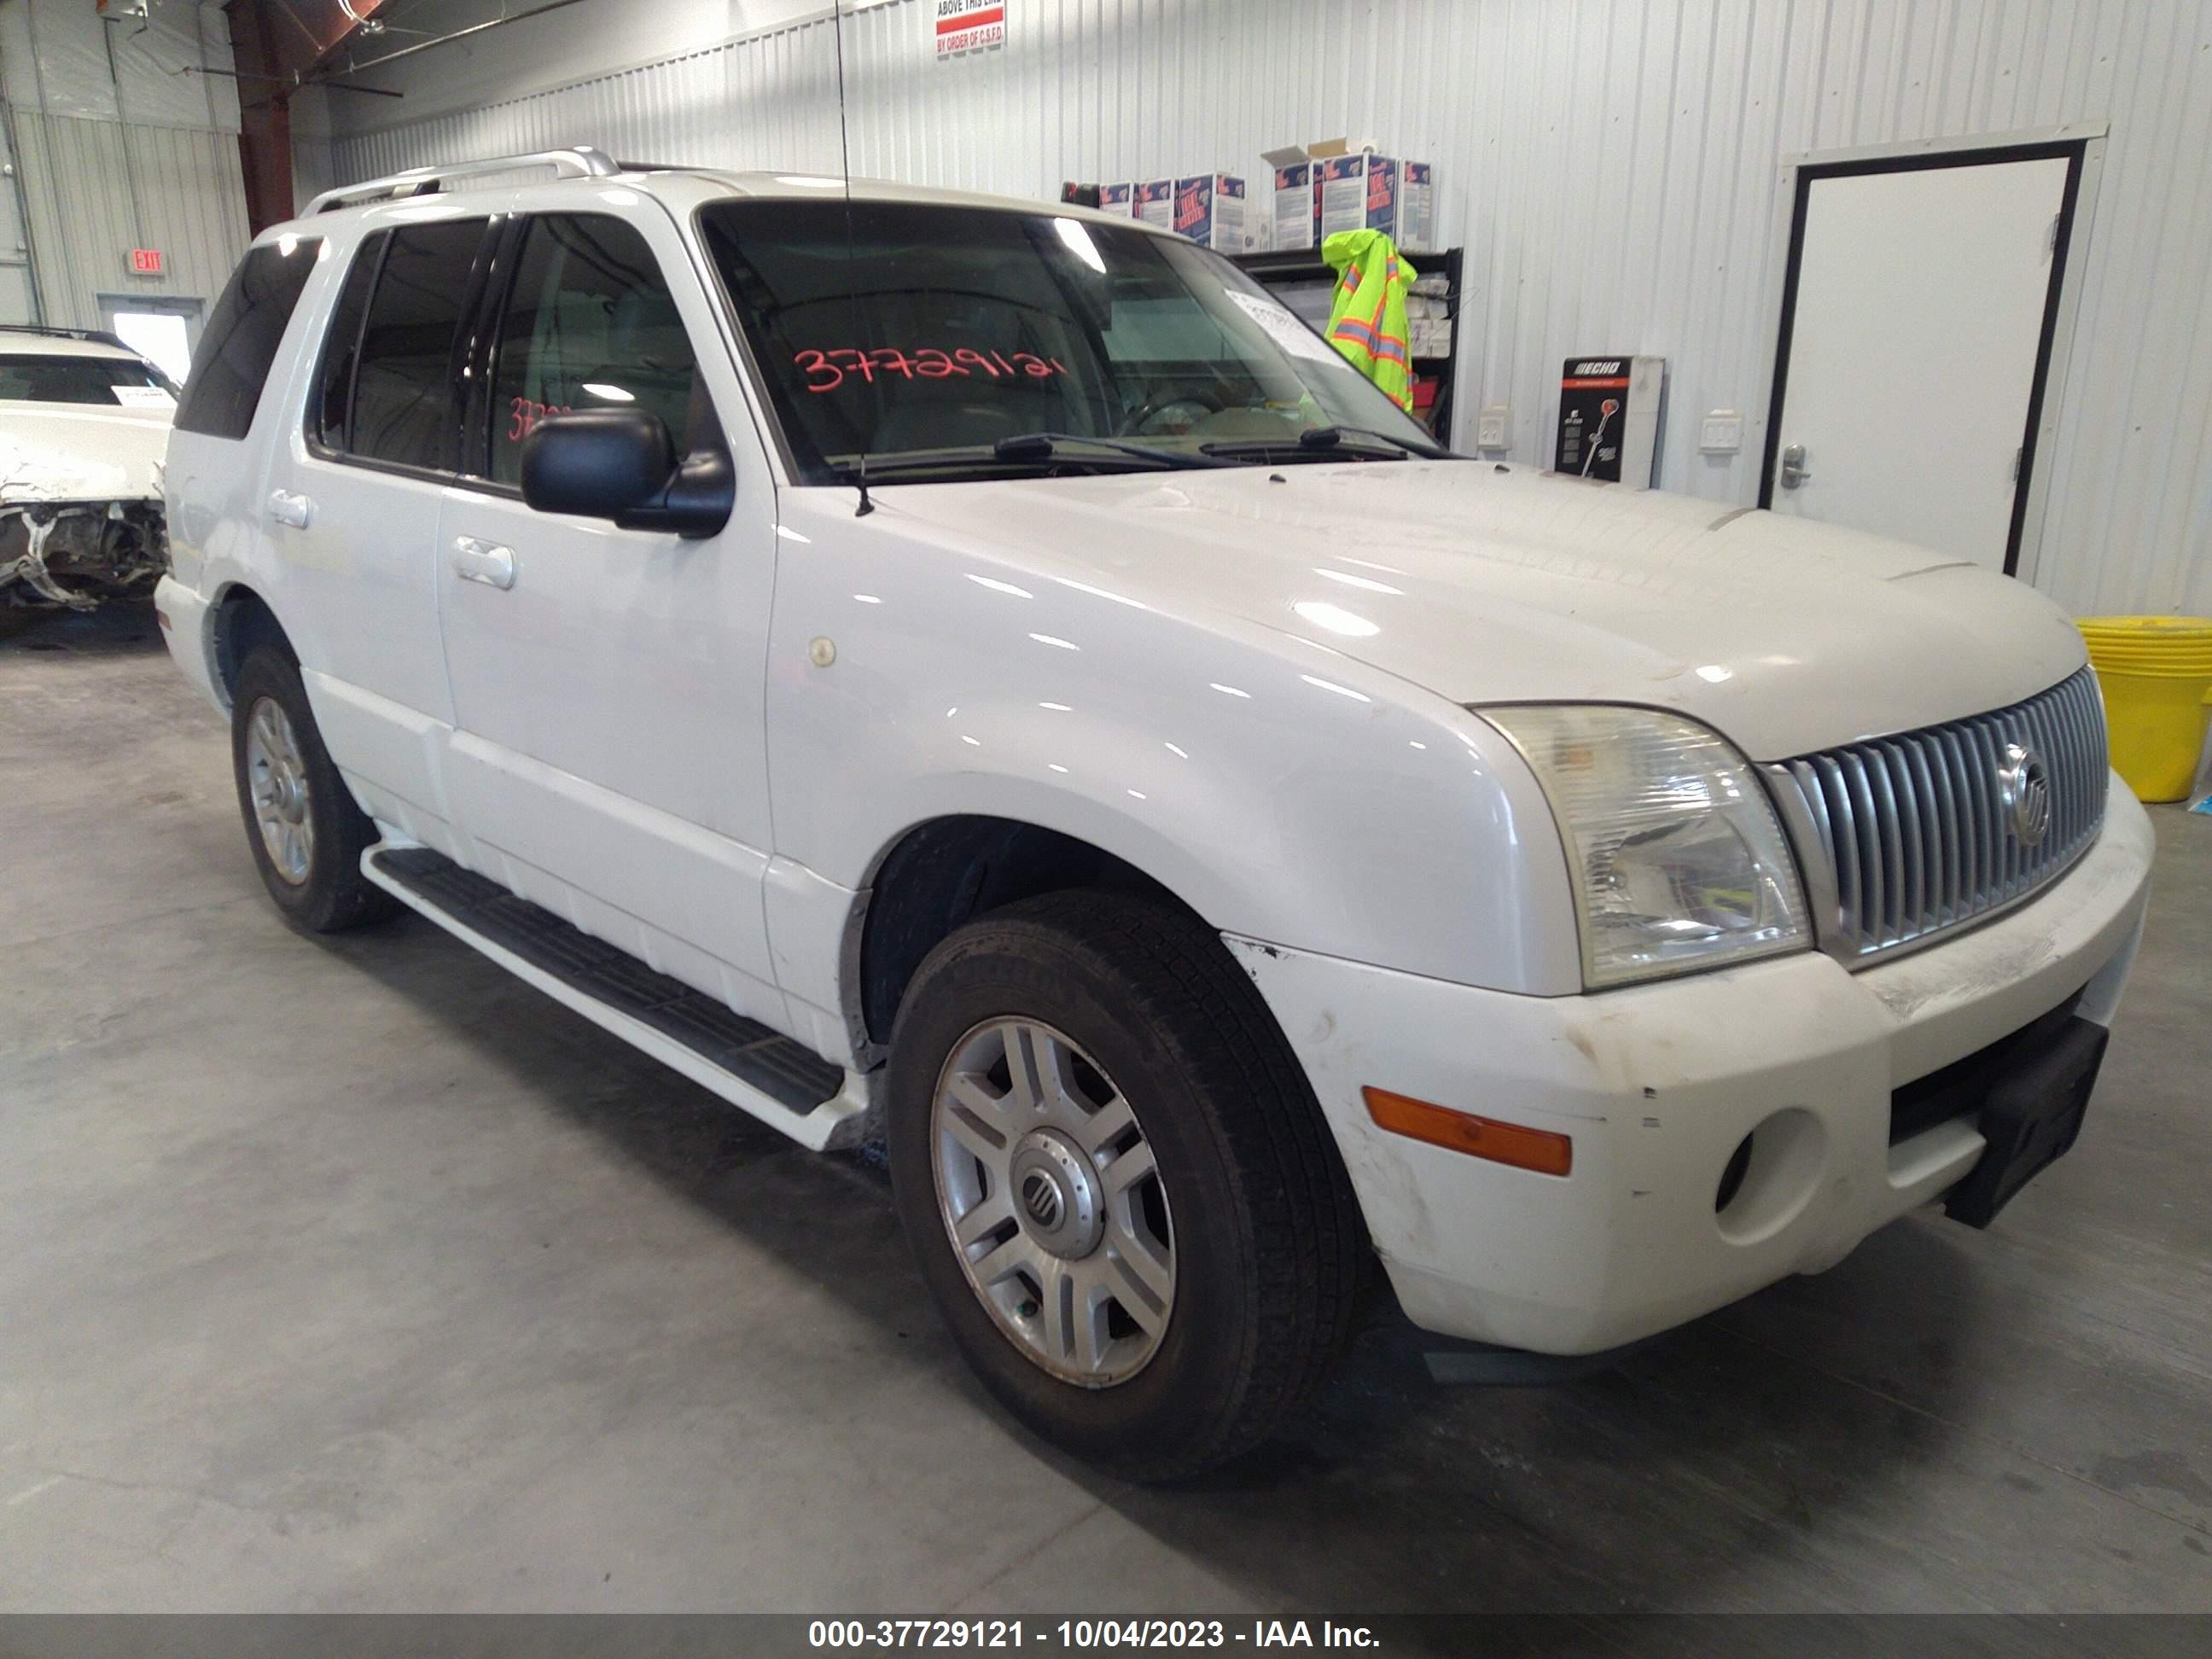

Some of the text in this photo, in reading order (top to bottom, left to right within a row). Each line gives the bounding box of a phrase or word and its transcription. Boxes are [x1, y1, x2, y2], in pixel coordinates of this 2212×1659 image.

[938, 0, 963, 16] ABOVE
[937, 37, 946, 53] BY
[947, 33, 969, 50] ORDER
[970, 30, 979, 46] OF
[135, 250, 160, 271] EXIT
[795, 347, 1068, 393] 37729121
[1583, 361, 1621, 375] ECHO
